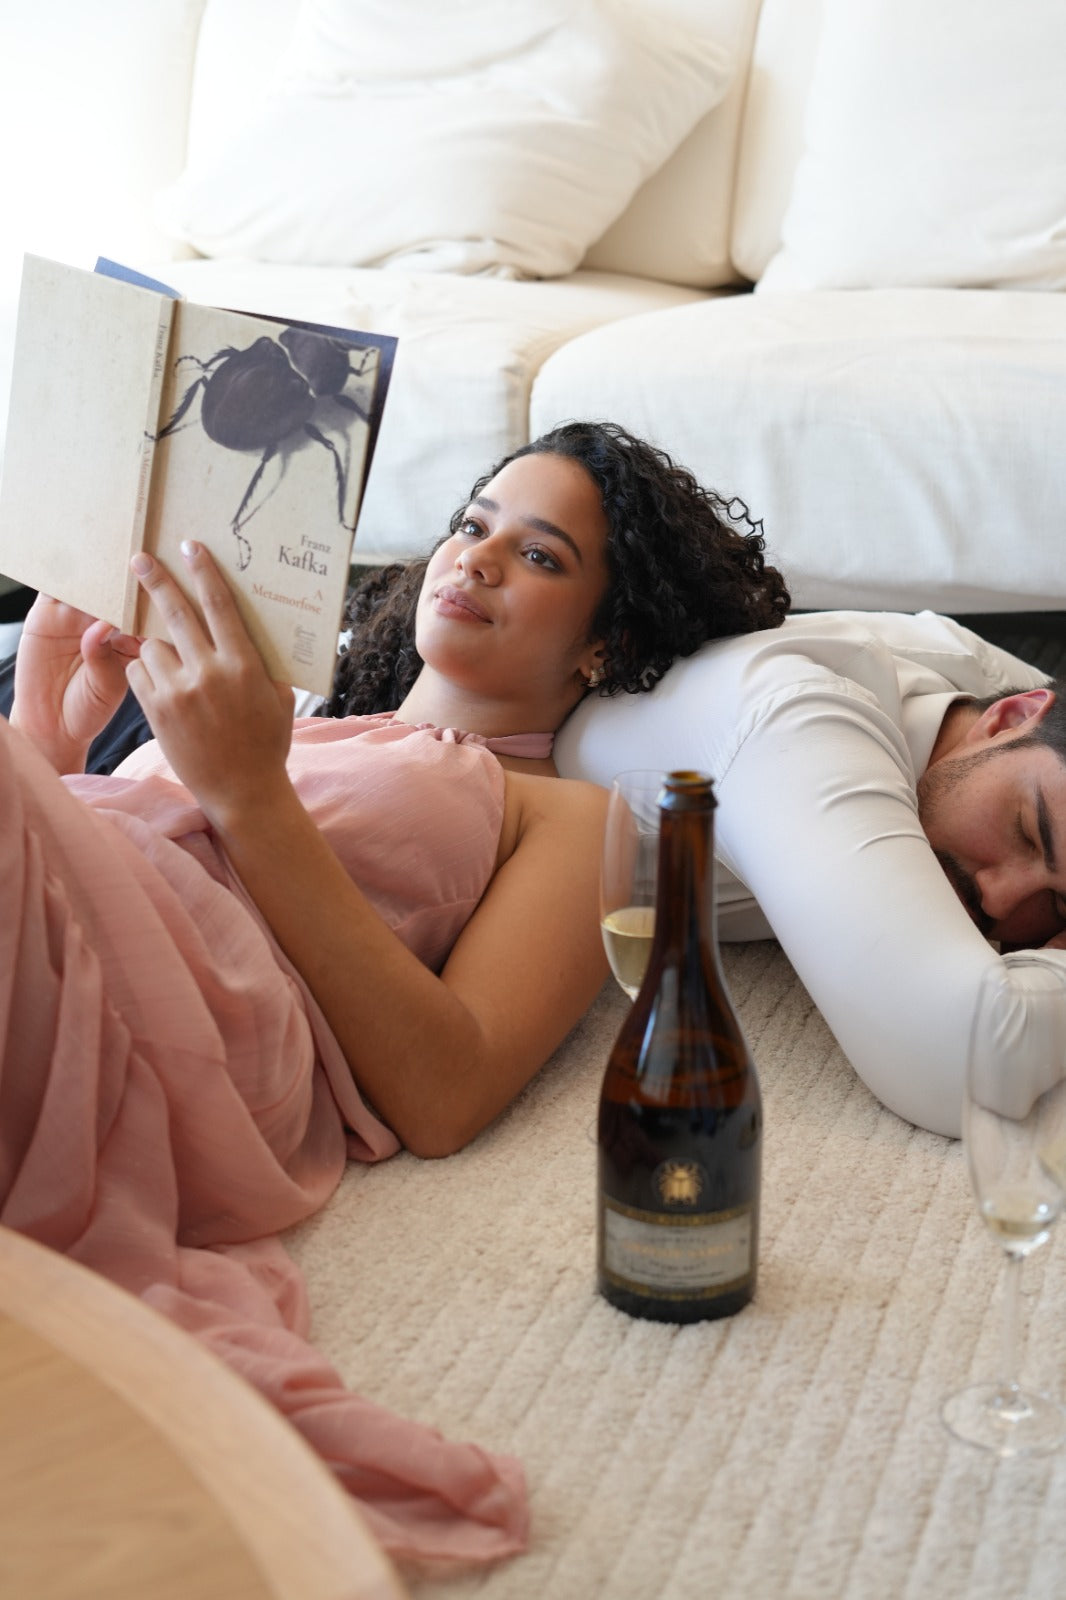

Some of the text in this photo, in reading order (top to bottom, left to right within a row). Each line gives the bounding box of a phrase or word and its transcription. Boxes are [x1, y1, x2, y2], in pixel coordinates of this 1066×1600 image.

[301, 534, 332, 553] Franz
[279, 545, 328, 577] Kafka
[252, 583, 322, 615] Metamorfose
[314, 589, 324, 601] A
